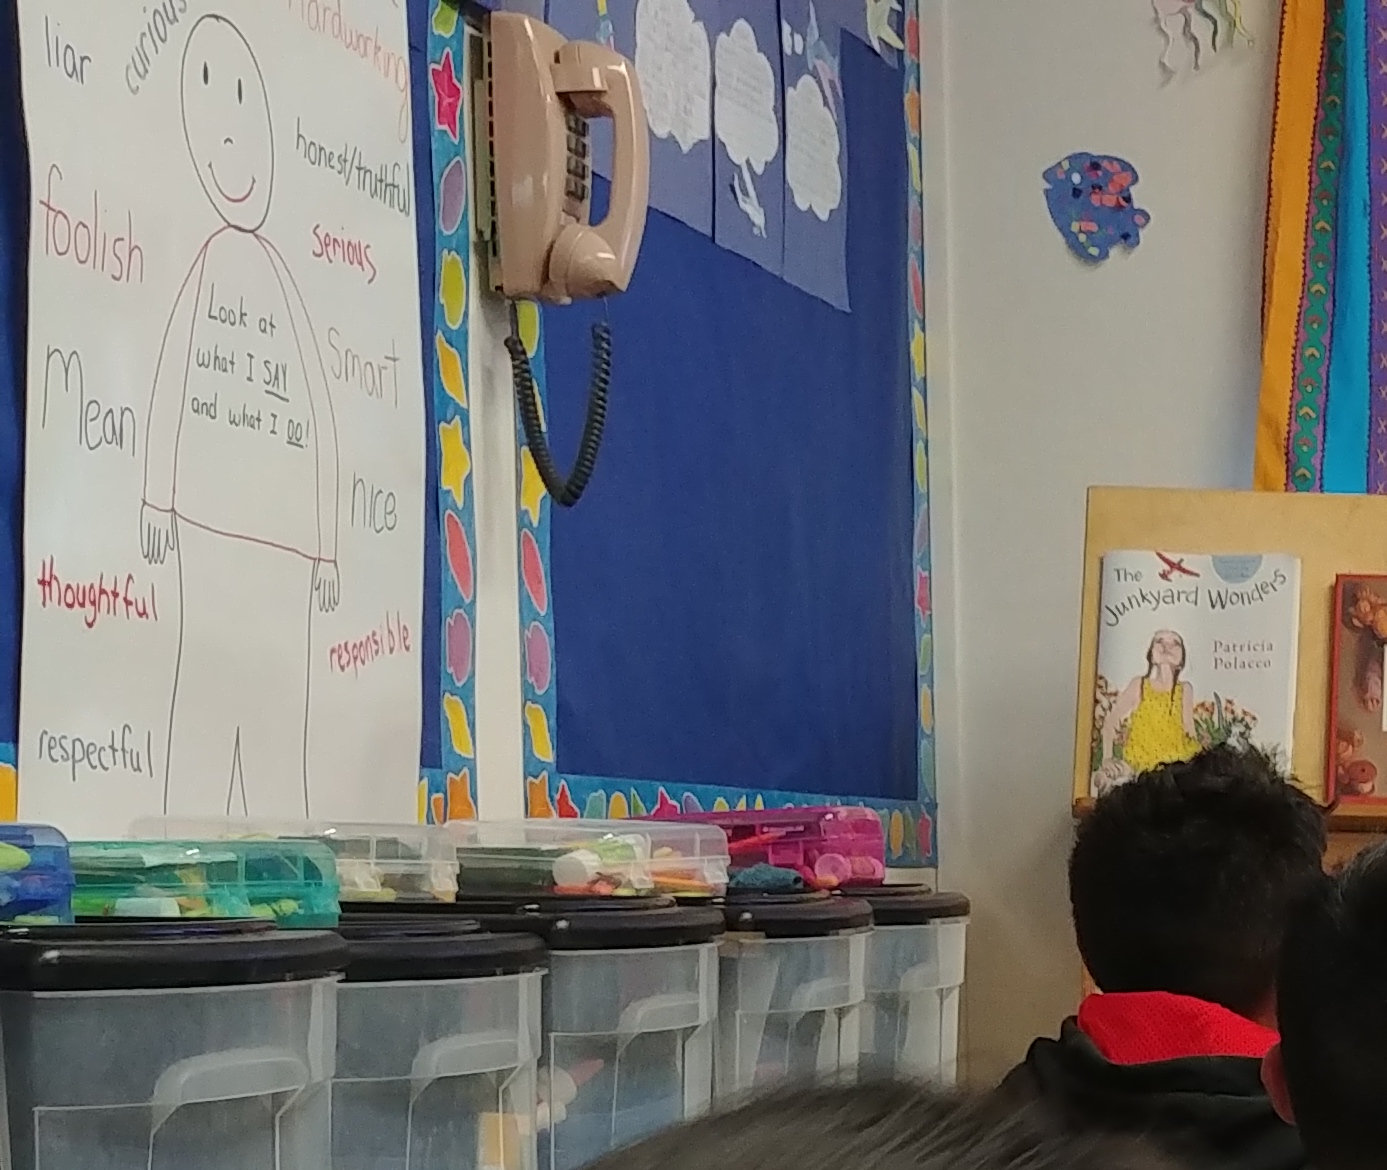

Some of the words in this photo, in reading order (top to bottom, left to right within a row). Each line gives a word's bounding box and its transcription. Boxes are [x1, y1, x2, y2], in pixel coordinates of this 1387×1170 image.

[45, 15, 92, 85] liar
[296, 116, 410, 217] honest/truthful
[39, 163, 144, 283] foolish
[208, 282, 248, 328] Look
[258, 313, 277, 338] at
[196, 344, 236, 375] what
[246, 352, 255, 382] I
[263, 360, 289, 393] SAY
[191, 392, 218, 420] and
[229, 403, 262, 431] what
[270, 412, 278, 435] I
[351, 471, 398, 534] nice
[37, 554, 158, 628] thoughtful
[1105, 586, 1200, 627] Junkyard
[1207, 569, 1287, 610] Wonders
[1114, 568, 1143, 583] The
[329, 612, 411, 680] responsible
[1213, 640, 1274, 654] Patricia
[1213, 658, 1272, 670] Polacco
[38, 724, 154, 782] respectful
